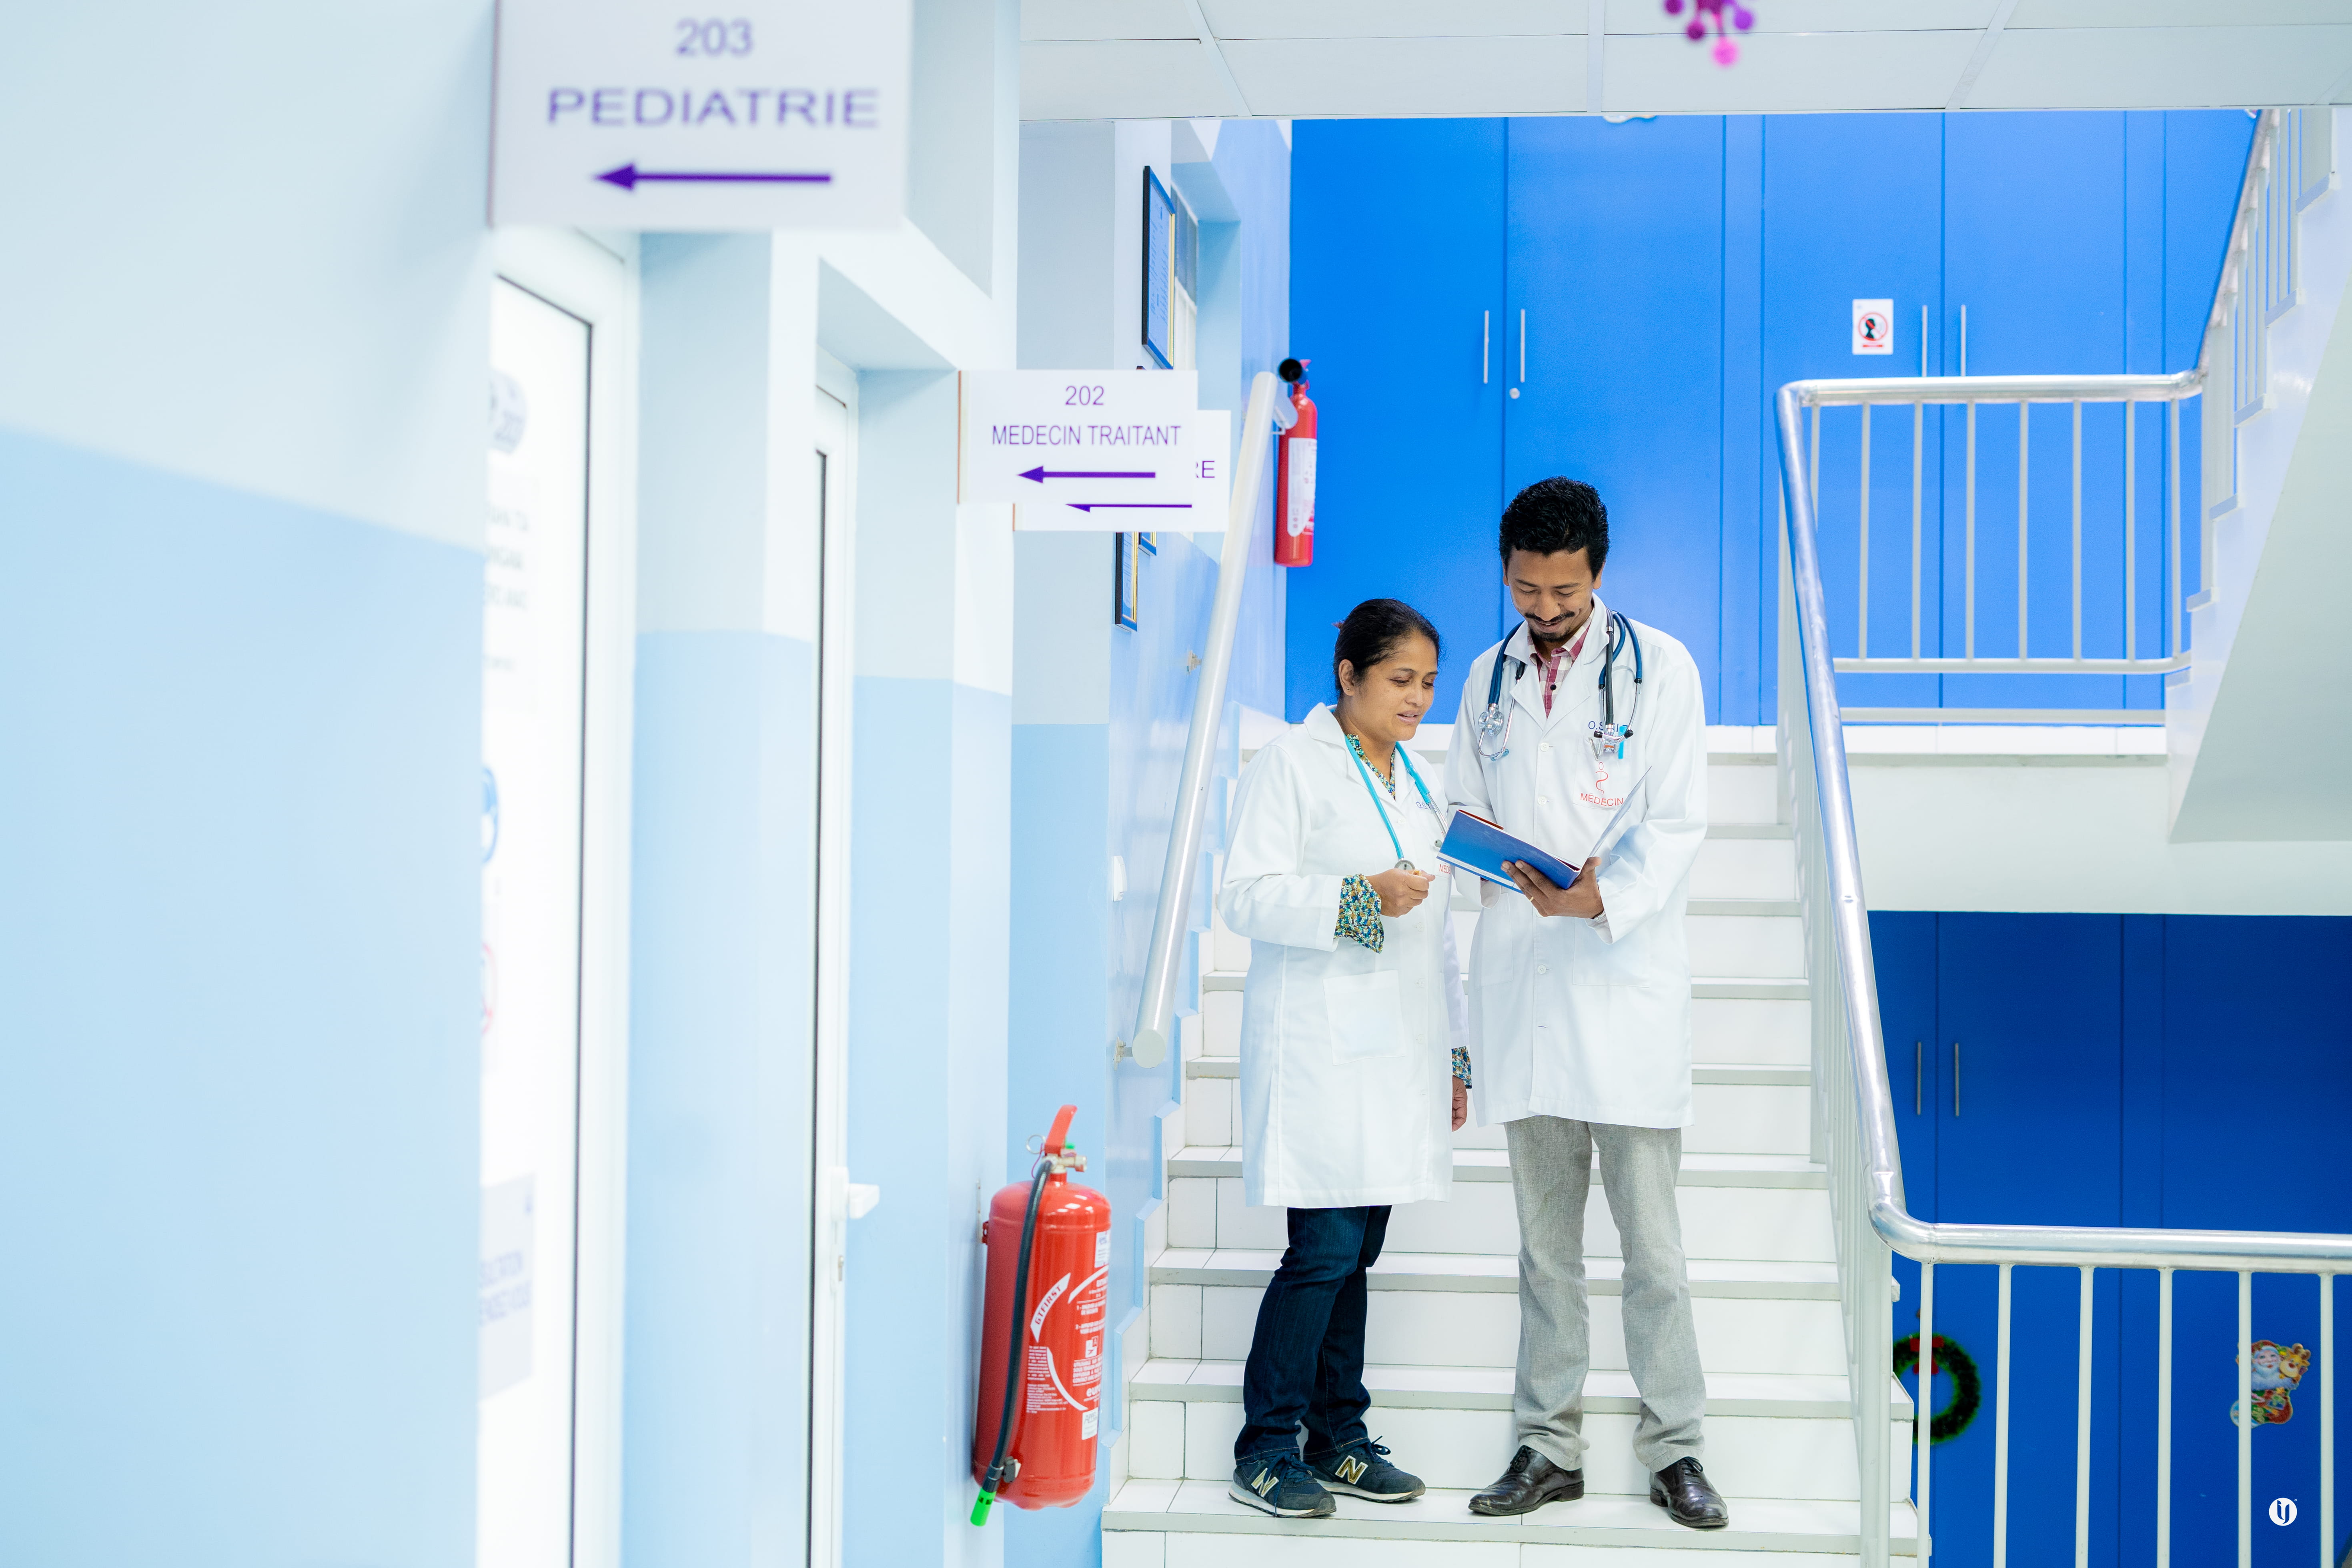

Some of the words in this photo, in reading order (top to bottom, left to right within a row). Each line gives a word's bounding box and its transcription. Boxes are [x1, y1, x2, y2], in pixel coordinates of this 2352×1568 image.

[675, 18, 754, 57] 203
[547, 88, 879, 127] PEDIATRIE
[1065, 386, 1104, 405] 202
[993, 425, 1080, 445] MEDECIN
[1088, 425, 1181, 445] TRAITANT
[1196, 461, 1215, 478] E
[1580, 793, 1623, 807] MEDECIN
[1335, 1455, 1368, 1484] N
